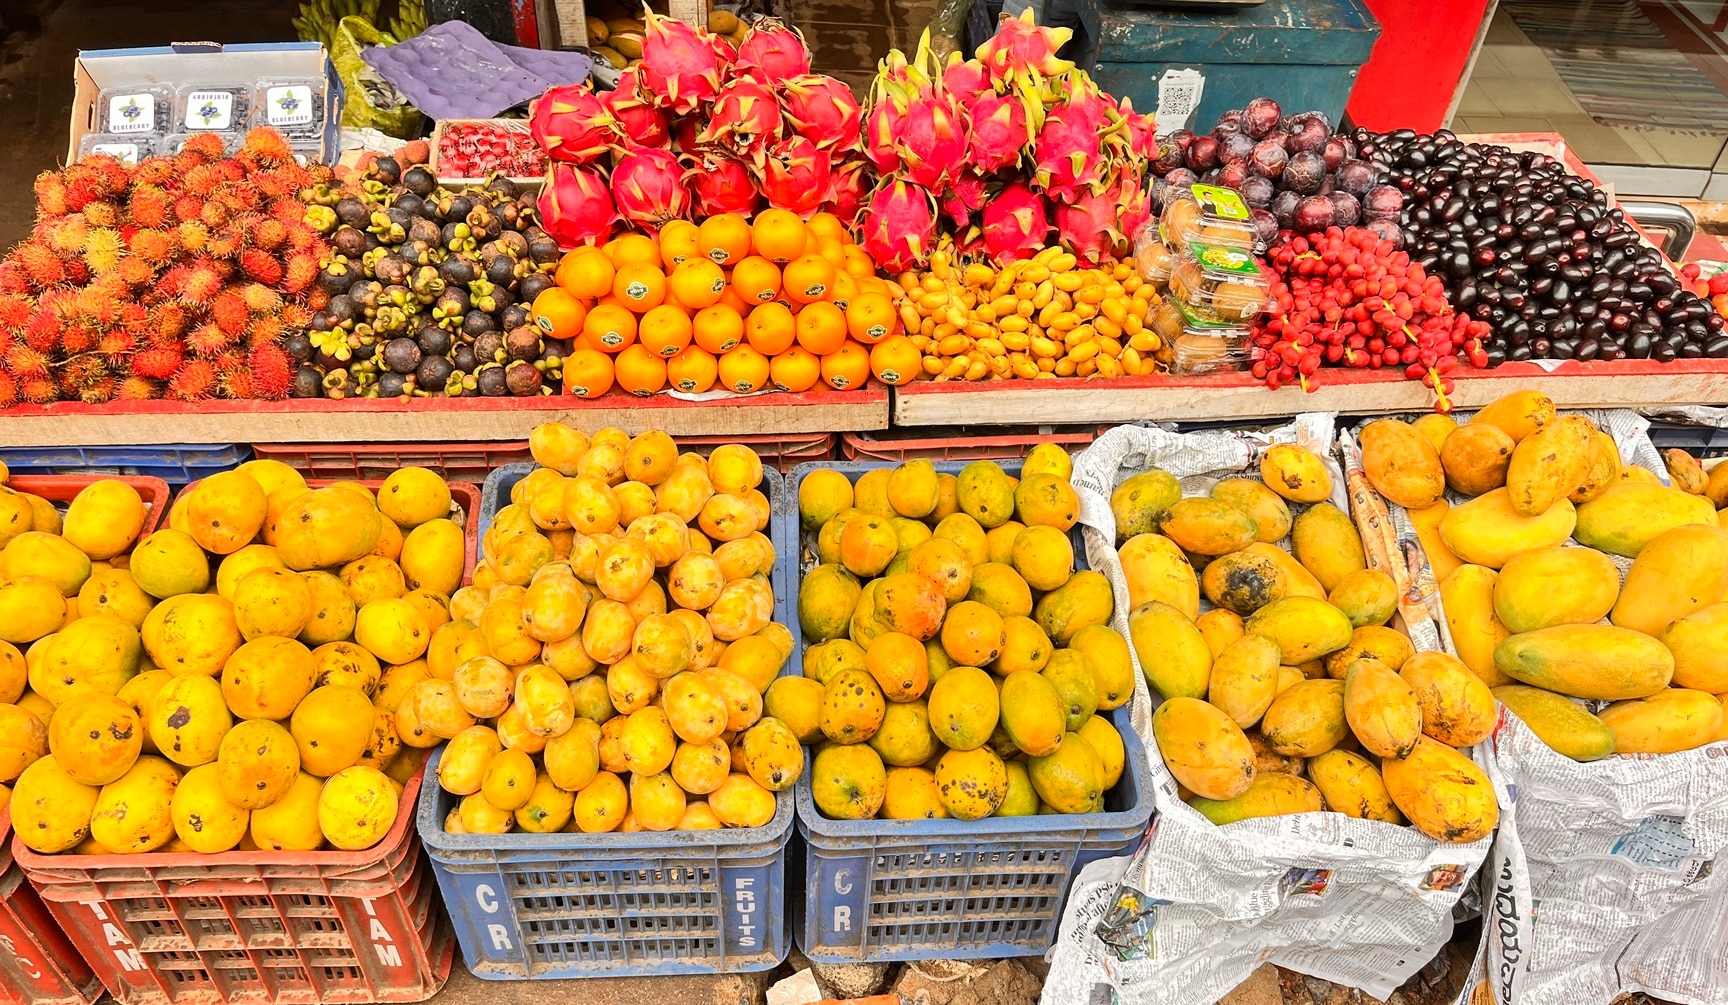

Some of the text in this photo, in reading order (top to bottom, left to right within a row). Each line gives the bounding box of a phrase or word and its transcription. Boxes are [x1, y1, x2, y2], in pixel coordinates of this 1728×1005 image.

[113, 123, 151, 131] BLUEBERRY
[271, 115, 309, 123] BLUEBERRY
[79, 900, 150, 972] TAM
[354, 896, 403, 967] TAM
[735, 878, 756, 947] FRUITS
